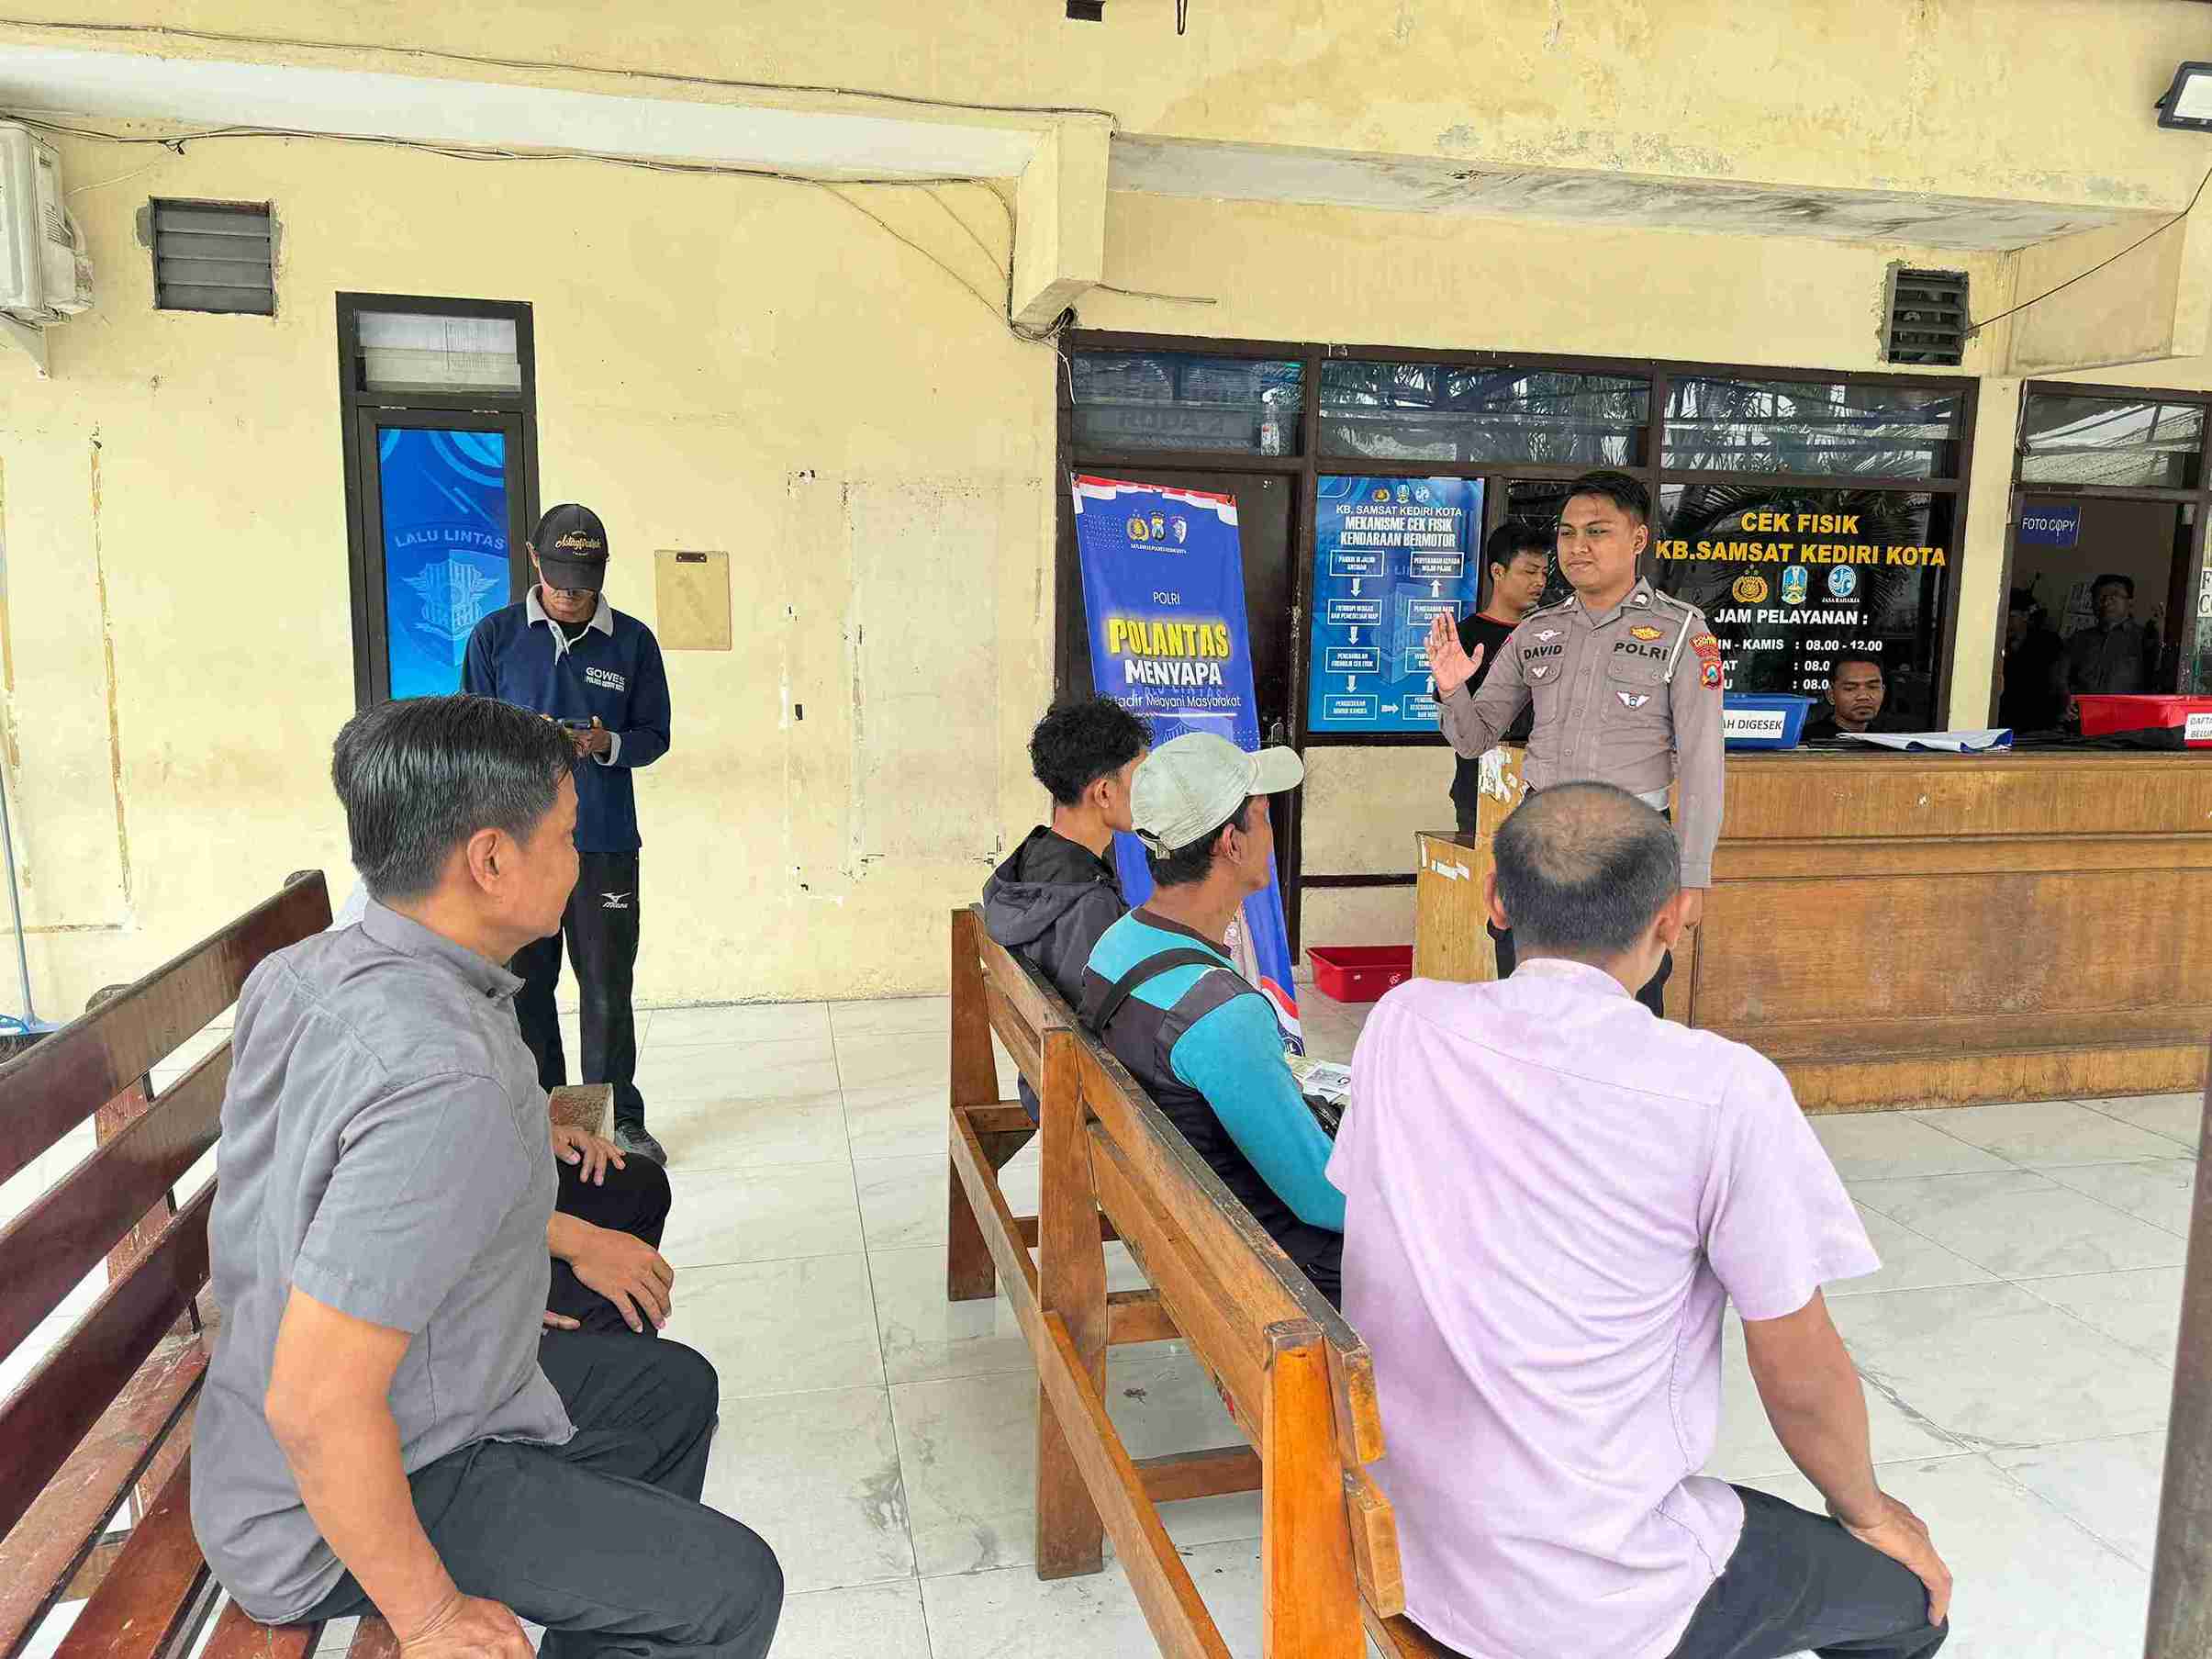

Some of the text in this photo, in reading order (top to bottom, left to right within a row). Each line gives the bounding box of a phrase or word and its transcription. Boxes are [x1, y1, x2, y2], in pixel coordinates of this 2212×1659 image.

[1336, 504, 1462, 516] KB. SAMSAT KEDIRI KOTA
[1345, 516, 1452, 532] MEKANISME CEK FISIK
[1740, 512, 1860, 535] CEK FISIK
[2022, 517, 2077, 532] FOTO COPY
[395, 529, 505, 550] LALU LINTAS
[1340, 532, 1456, 547] KENDARAAN BERMOTOR
[1655, 540, 1946, 566] KB.SAMSAT KEDIRI KOTA
[1153, 591, 1180, 605] POLRI
[1714, 609, 1751, 623] JAM
[1757, 609, 1858, 625] PELAYANAN
[1108, 618, 1229, 657] POLANTAS
[1524, 645, 1562, 660] DAVID
[1614, 642, 1668, 661] POLRI
[1743, 639, 1784, 650] KAMIS
[1805, 640, 1839, 651] 08.00
[1851, 640, 1882, 652] 12.00
[1124, 659, 1223, 686] MENYAPA
[1804, 660, 1830, 671] 08.0
[1803, 678, 1829, 690] 08.0
[1147, 695, 1185, 711] Melayani
[1187, 695, 1242, 711] Masyarakat
[1738, 719, 1782, 731] DIGESEK
